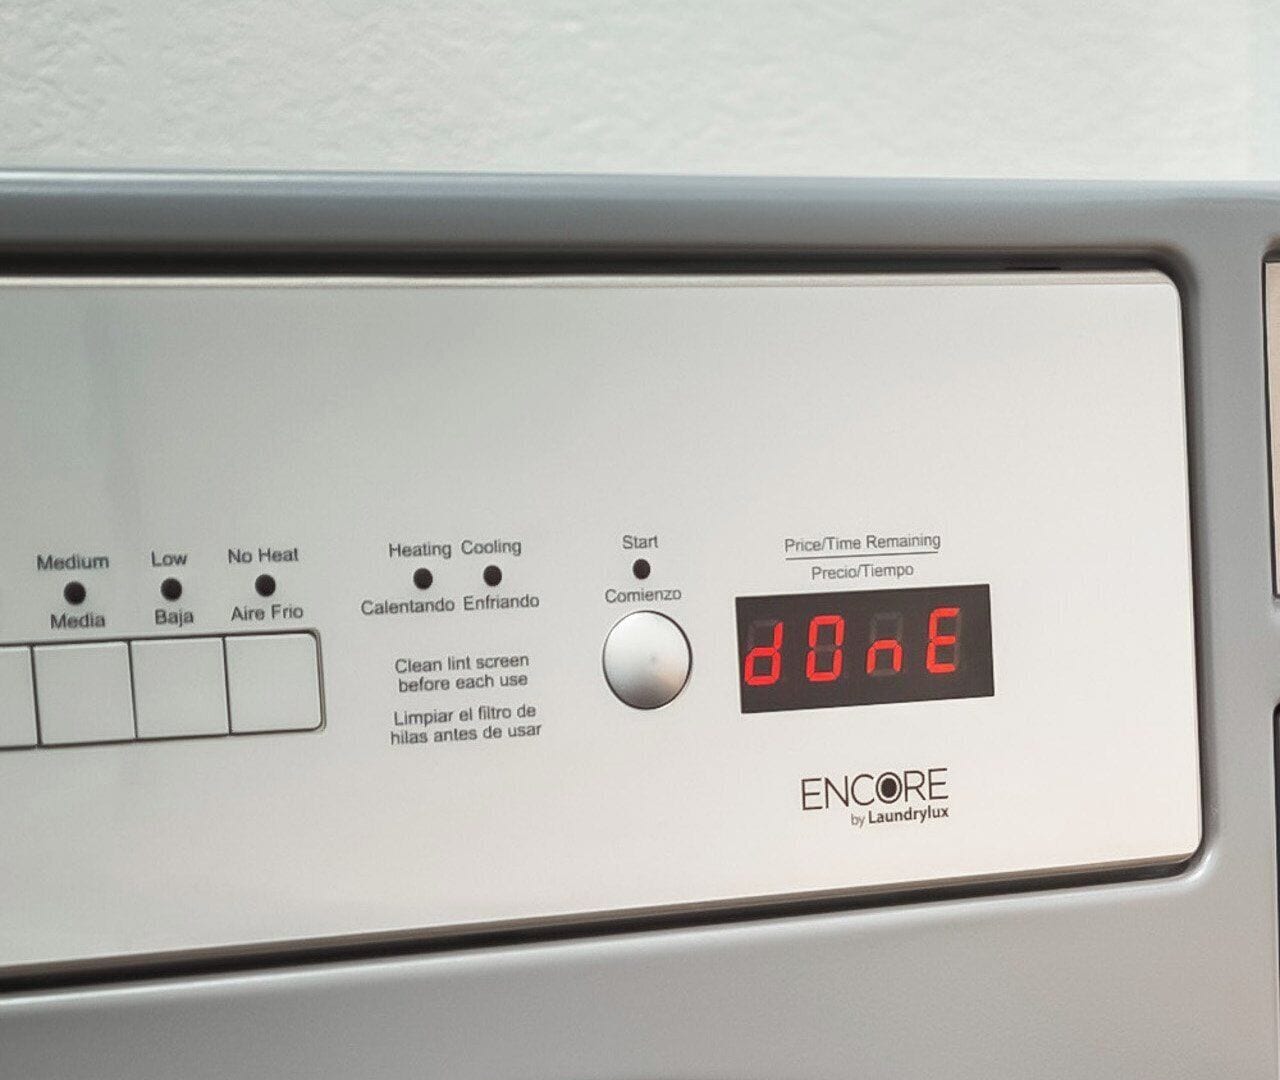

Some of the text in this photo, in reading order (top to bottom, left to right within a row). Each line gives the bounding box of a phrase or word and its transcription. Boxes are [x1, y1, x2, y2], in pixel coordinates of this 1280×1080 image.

[389, 539, 521, 559] Heating Cooling
[623, 535, 658, 549] Start
[784, 533, 942, 552] Price/Time Remaining
[37, 554, 109, 570] Medium
[151, 551, 187, 567] Low
[228, 548, 298, 563] No Heat
[812, 564, 914, 580] Precio/Tiempo
[361, 594, 539, 615] Calentando Enfriando
[605, 588, 681, 603] Comienzo
[51, 612, 105, 629] Media
[155, 609, 193, 627] Baja
[231, 606, 265, 621] Aire
[395, 654, 530, 674] Clean lint screen
[399, 673, 529, 693] before each use
[394, 704, 536, 727] Limpiar el filtro de
[390, 725, 541, 746] hilas antes de usar
[801, 767, 949, 811] ENCORE
[851, 805, 949, 828] by Laundrylux
